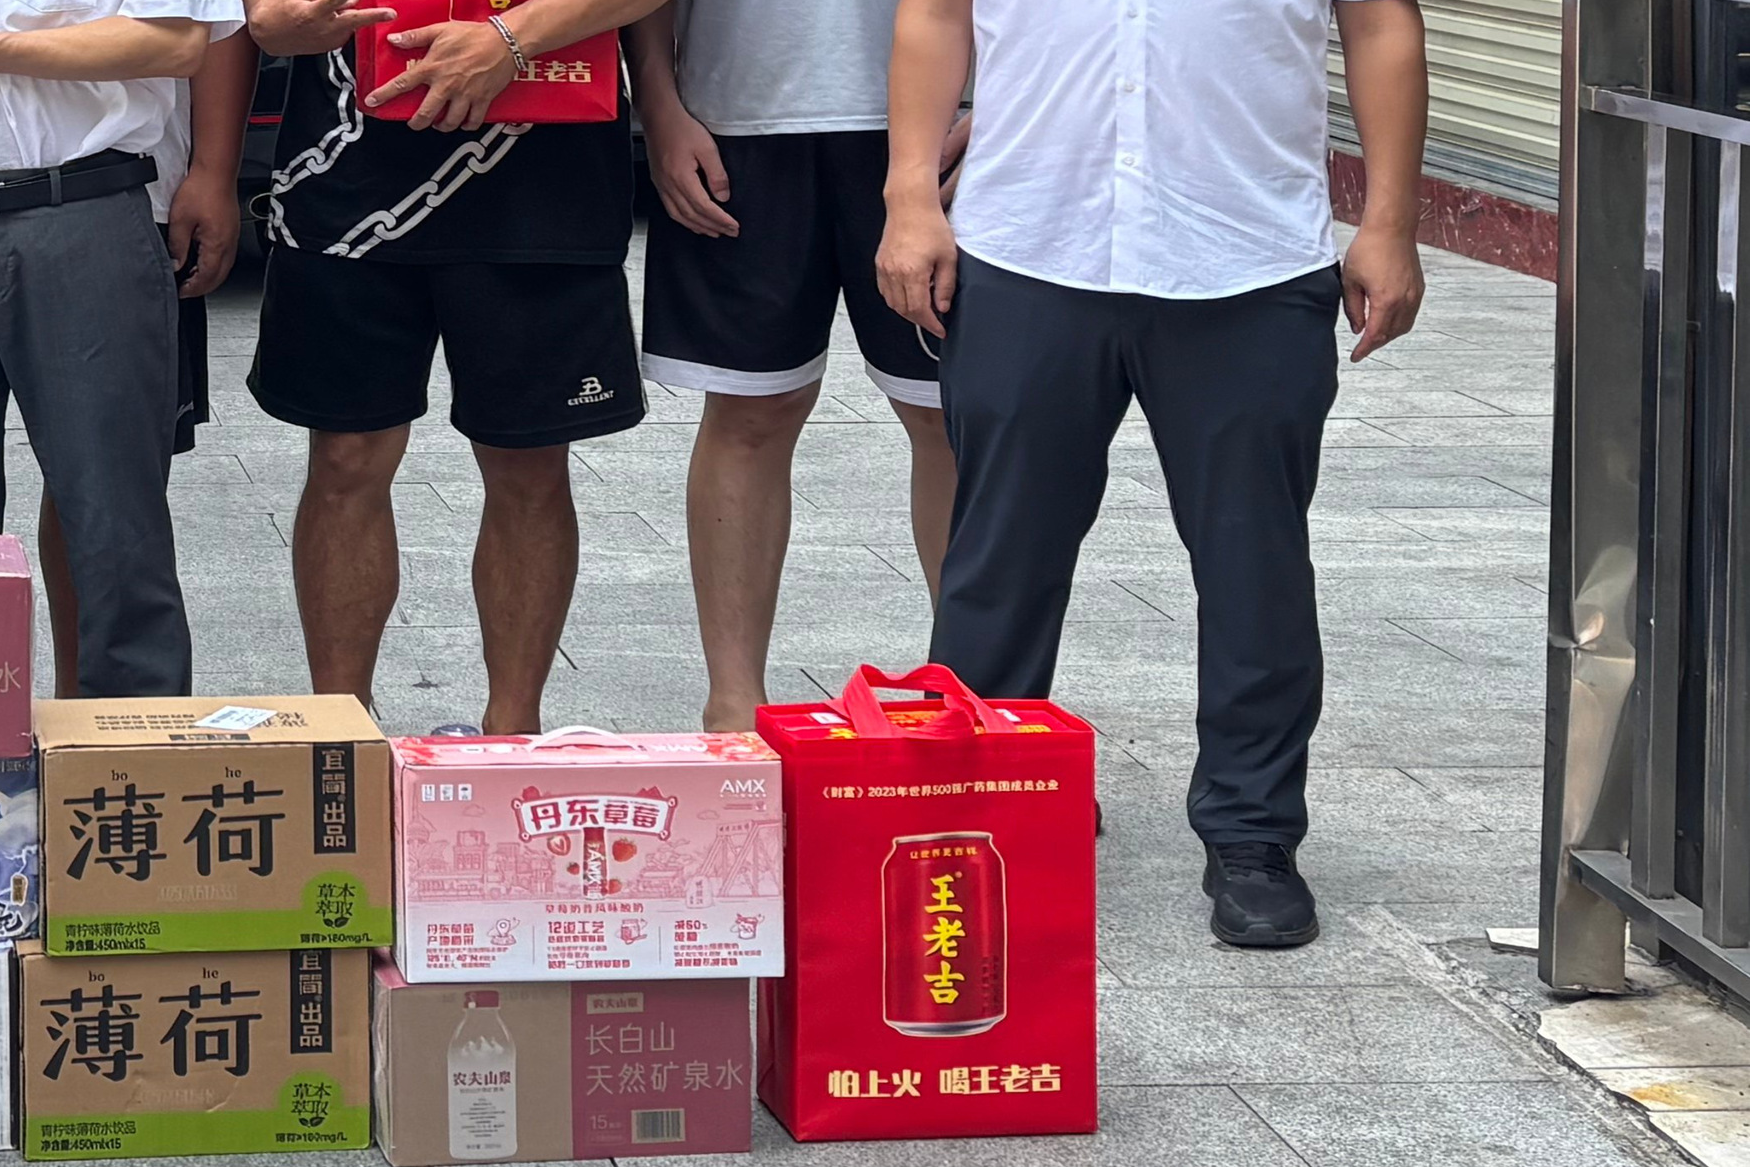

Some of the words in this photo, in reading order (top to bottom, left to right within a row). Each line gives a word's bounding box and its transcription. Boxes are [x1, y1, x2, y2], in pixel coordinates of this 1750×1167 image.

[111, 769, 128, 781] bo
[224, 765, 241, 779] he
[719, 779, 766, 793] AMX
[63, 780, 286, 881] 薄荷
[529, 799, 661, 832] 丹东草莓
[922, 873, 967, 1004] 王老吉
[88, 969, 105, 982] bo
[202, 967, 219, 979] he
[592, 997, 640, 1009] 农夫山泉
[40, 980, 263, 1082] 薄荷
[585, 1021, 675, 1056] 长白山
[452, 1070, 512, 1087] 农夫山泉
[586, 1059, 745, 1096] 天然矿泉水
[827, 1070, 922, 1099] 怕上火
[939, 1063, 1062, 1096] 喝王老吉
